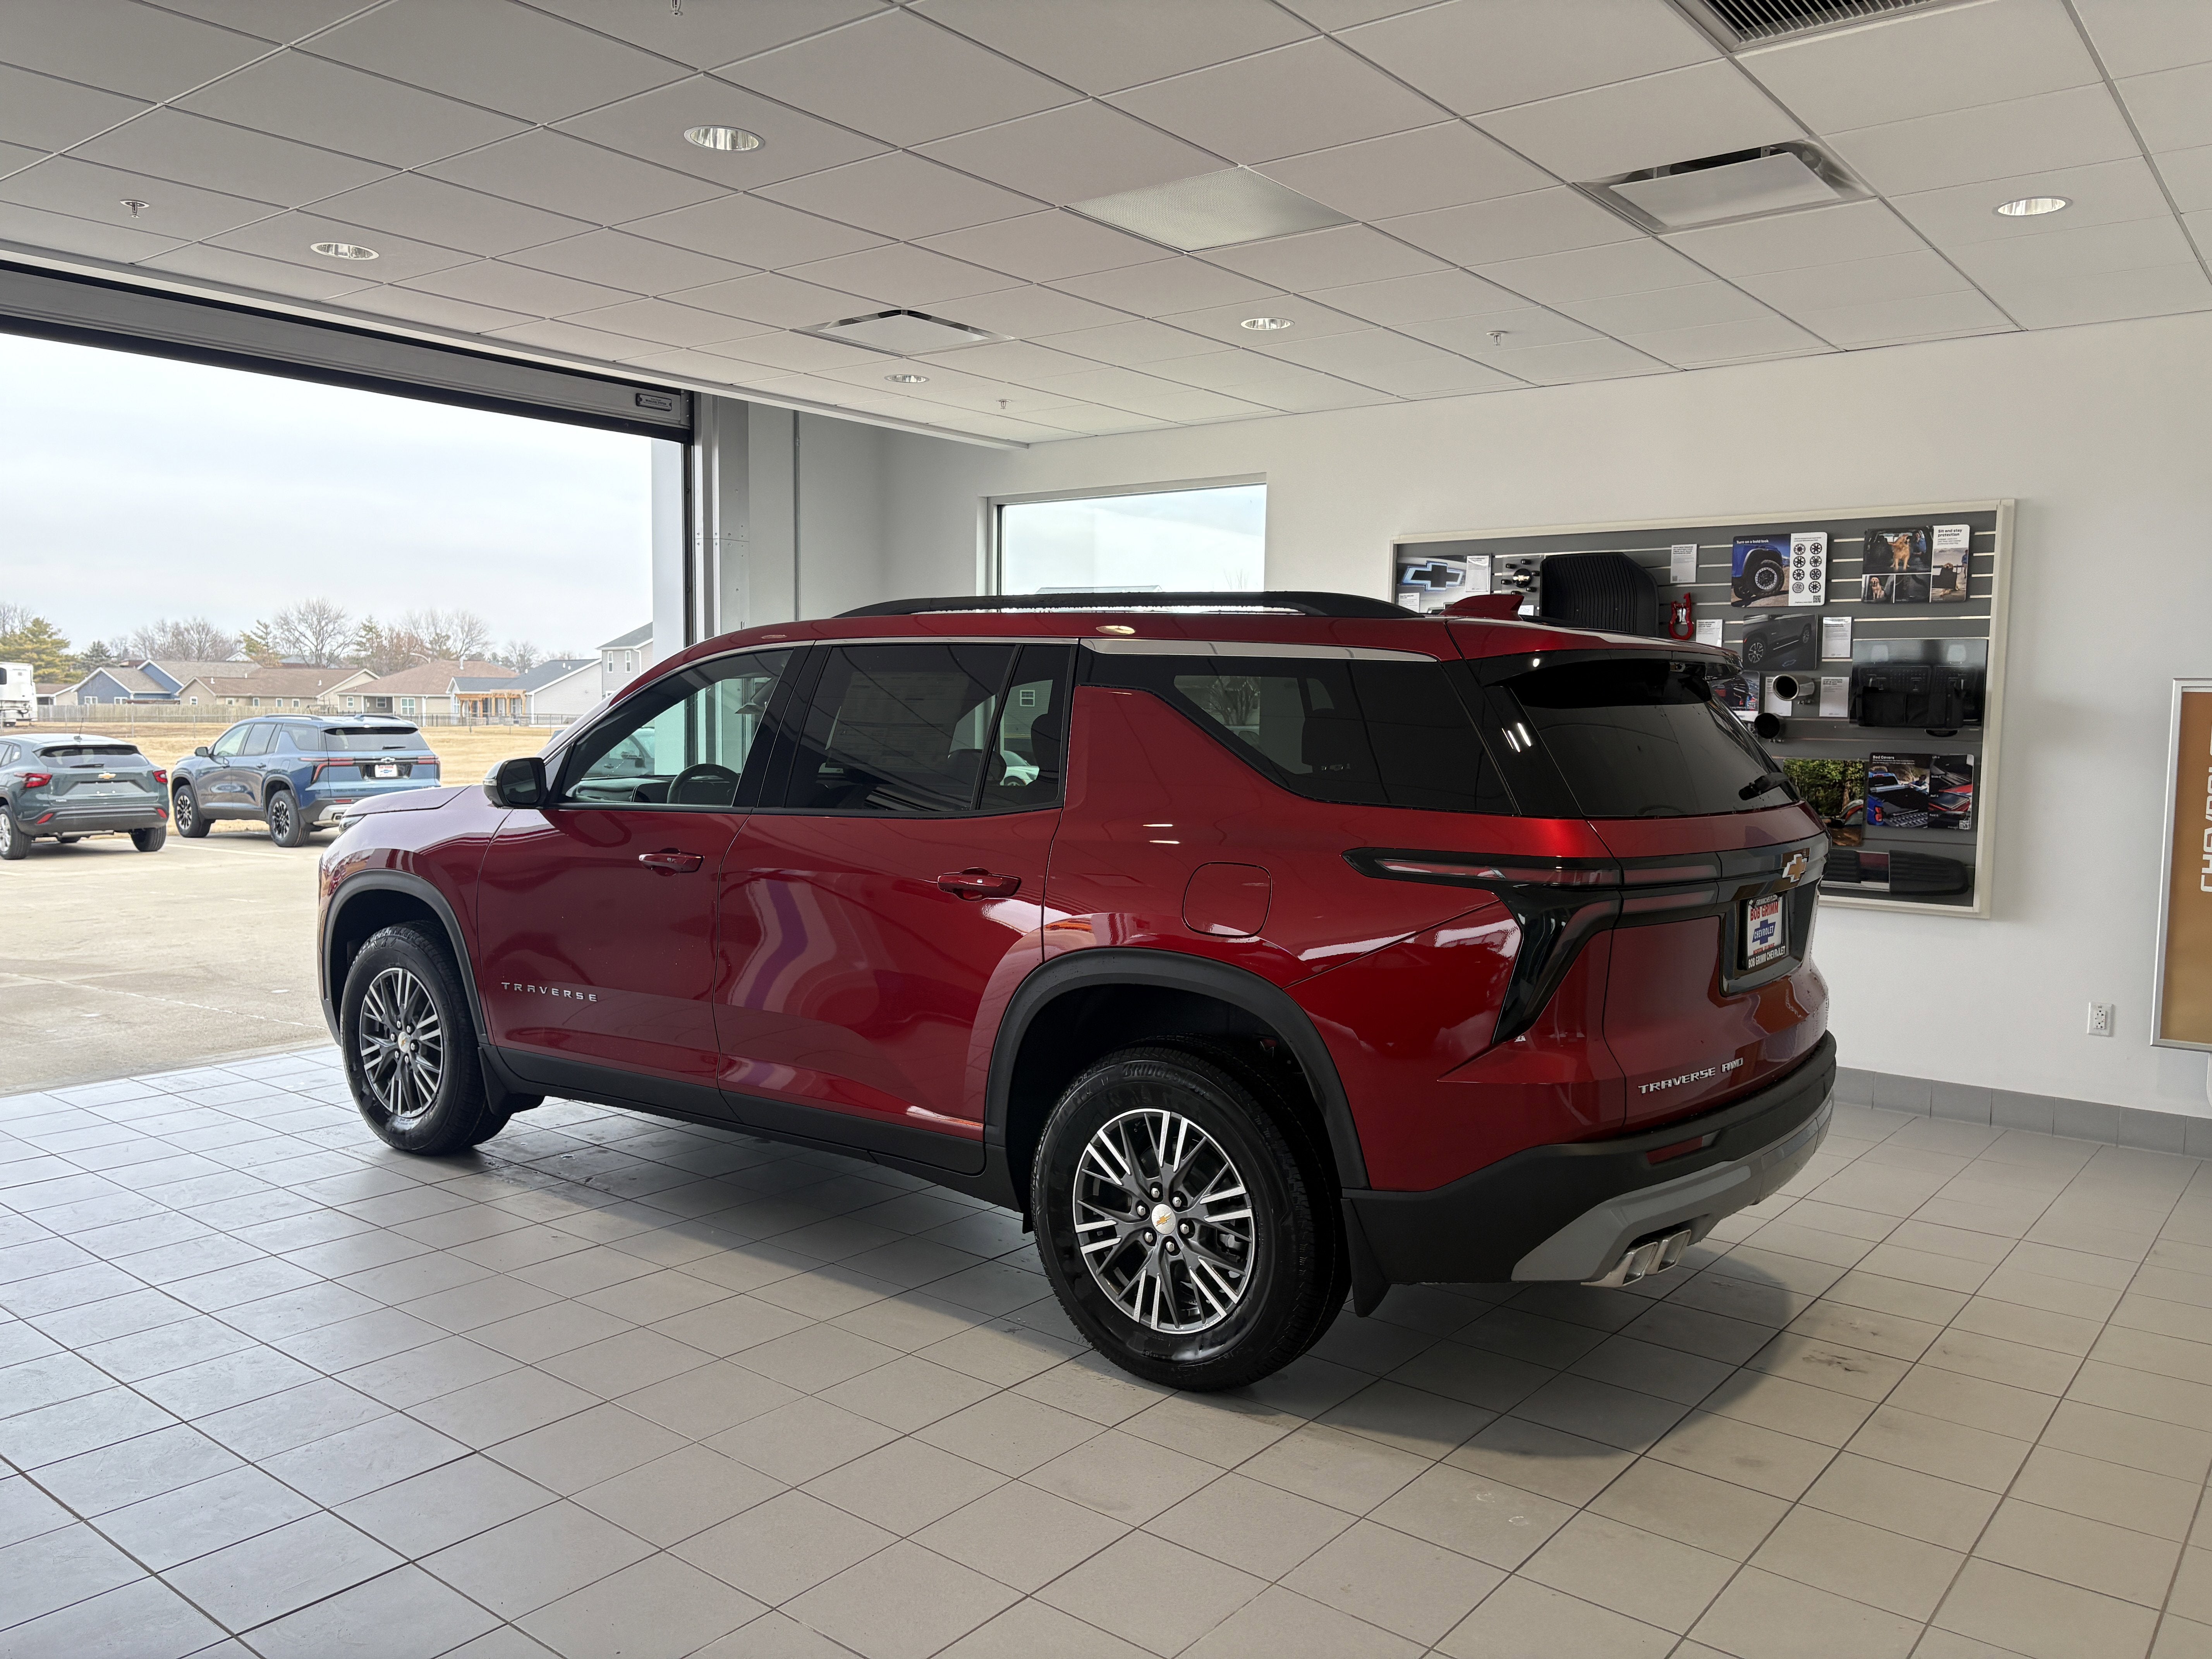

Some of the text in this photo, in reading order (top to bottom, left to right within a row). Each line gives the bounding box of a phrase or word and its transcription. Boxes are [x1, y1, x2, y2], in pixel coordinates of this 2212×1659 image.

[1750, 901, 1779, 921] BOB GRIMM
[1754, 925, 1774, 939] CHEVROLET
[501, 982, 598, 1002] TRAVERSE
[1638, 1058, 1743, 1094] TRAVERSE AWD
